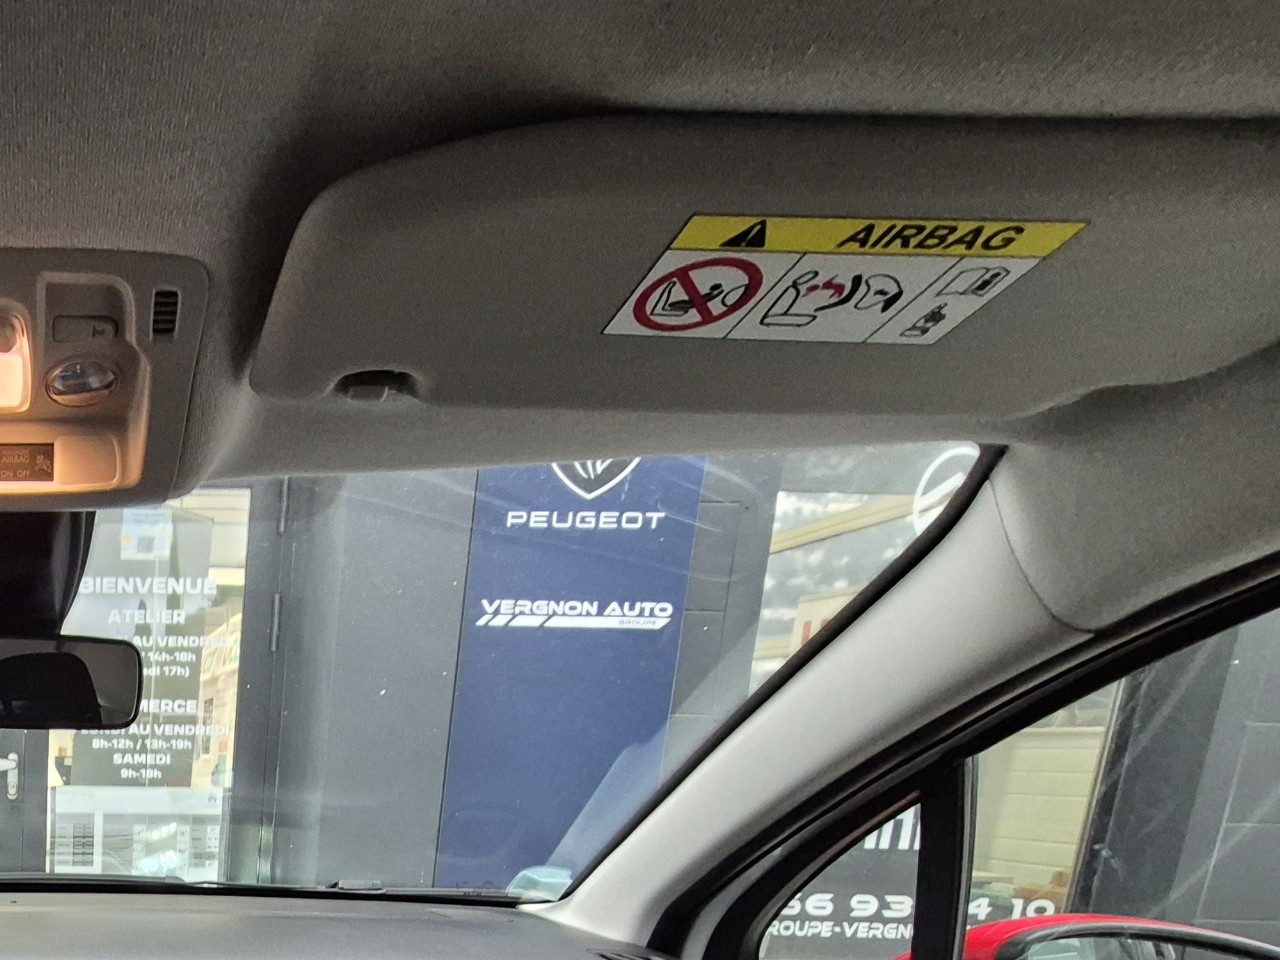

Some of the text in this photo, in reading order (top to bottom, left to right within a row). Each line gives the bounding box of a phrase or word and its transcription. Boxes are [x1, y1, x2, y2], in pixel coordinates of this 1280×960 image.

[837, 223, 1025, 251] AIRBAG
[506, 511, 665, 530] PEUGEOT
[79, 576, 217, 595] BIENVENUE
[108, 609, 186, 624] ATELIER
[481, 599, 674, 618] VERGNON AUTO
[133, 635, 153, 647] AU
[140, 699, 198, 713] MERCE
[128, 723, 150, 735] AU
[113, 753, 170, 765] SAMEDI
[849, 893, 914, 919] 93
[967, 897, 993, 920] 4
[768, 920, 914, 940] ROUPE-VERGN
